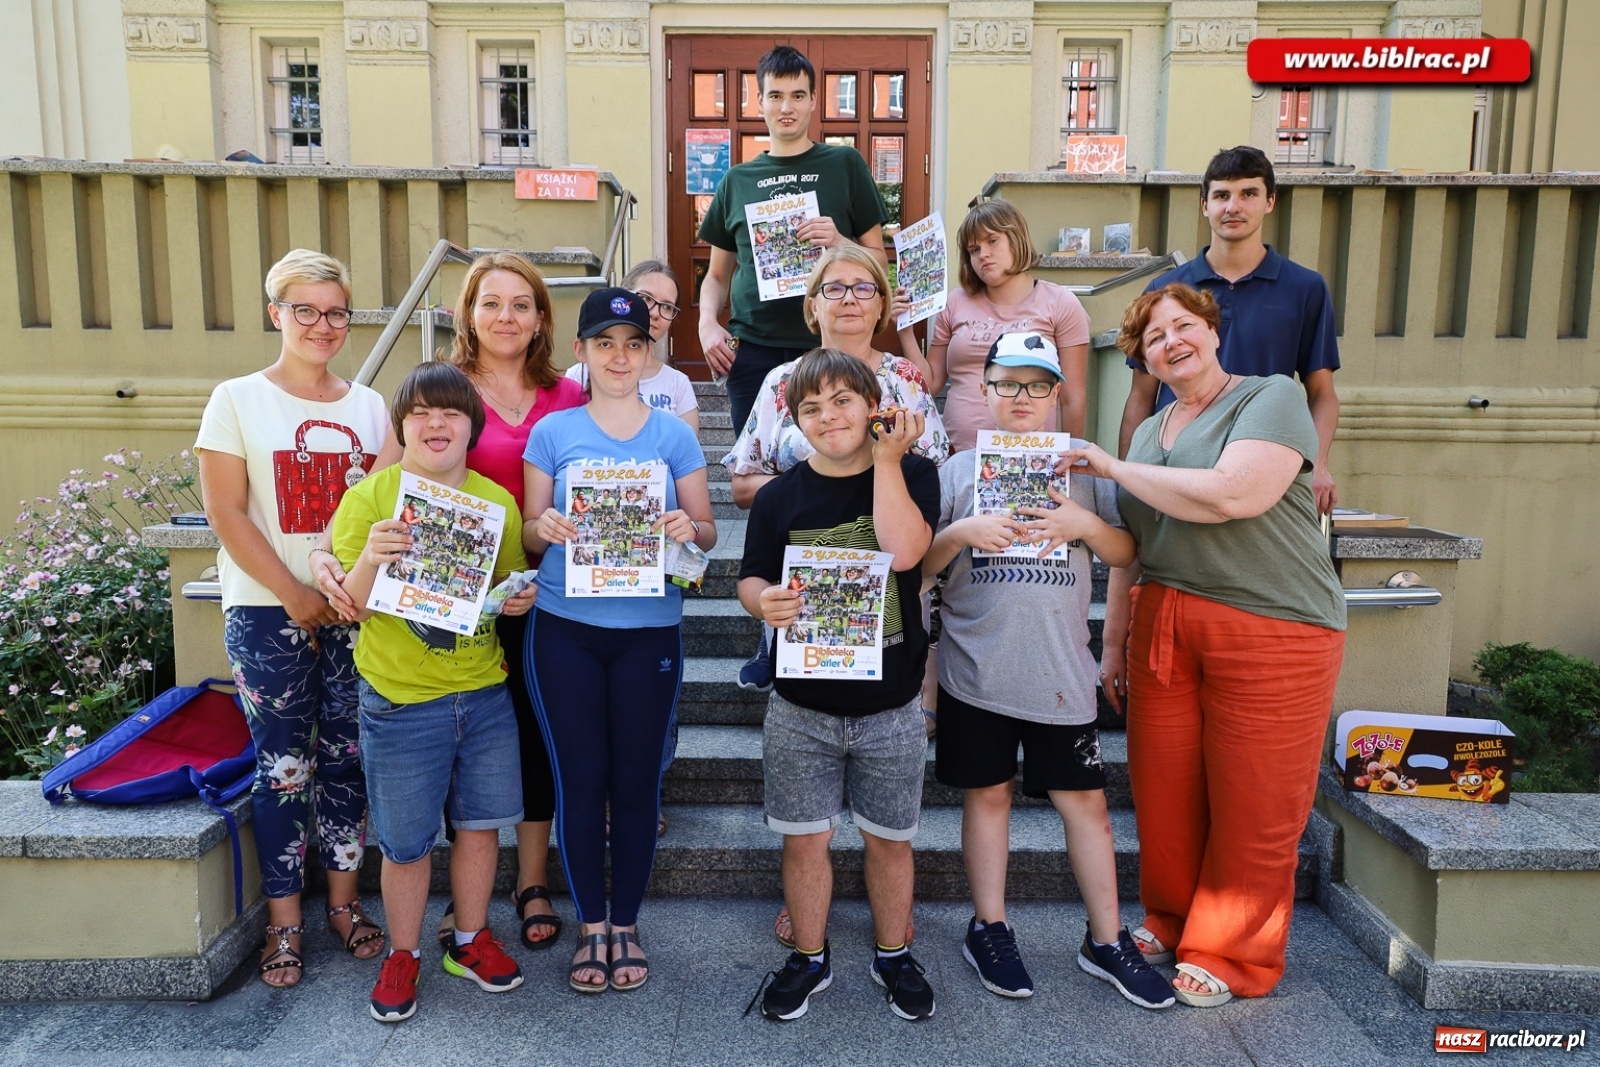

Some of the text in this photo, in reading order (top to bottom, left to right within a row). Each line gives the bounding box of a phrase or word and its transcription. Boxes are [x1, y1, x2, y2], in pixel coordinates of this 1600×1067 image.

[536, 172, 577, 186] KSIĄŻKI
[800, 174, 819, 182] 2017
[537, 187, 576, 198] ZA 1 ZŁ
[460, 639, 470, 649] IS
[1455, 739, 1503, 753] CZO-KOLE
[1453, 749, 1507, 762] #WOLEZOZOLE
